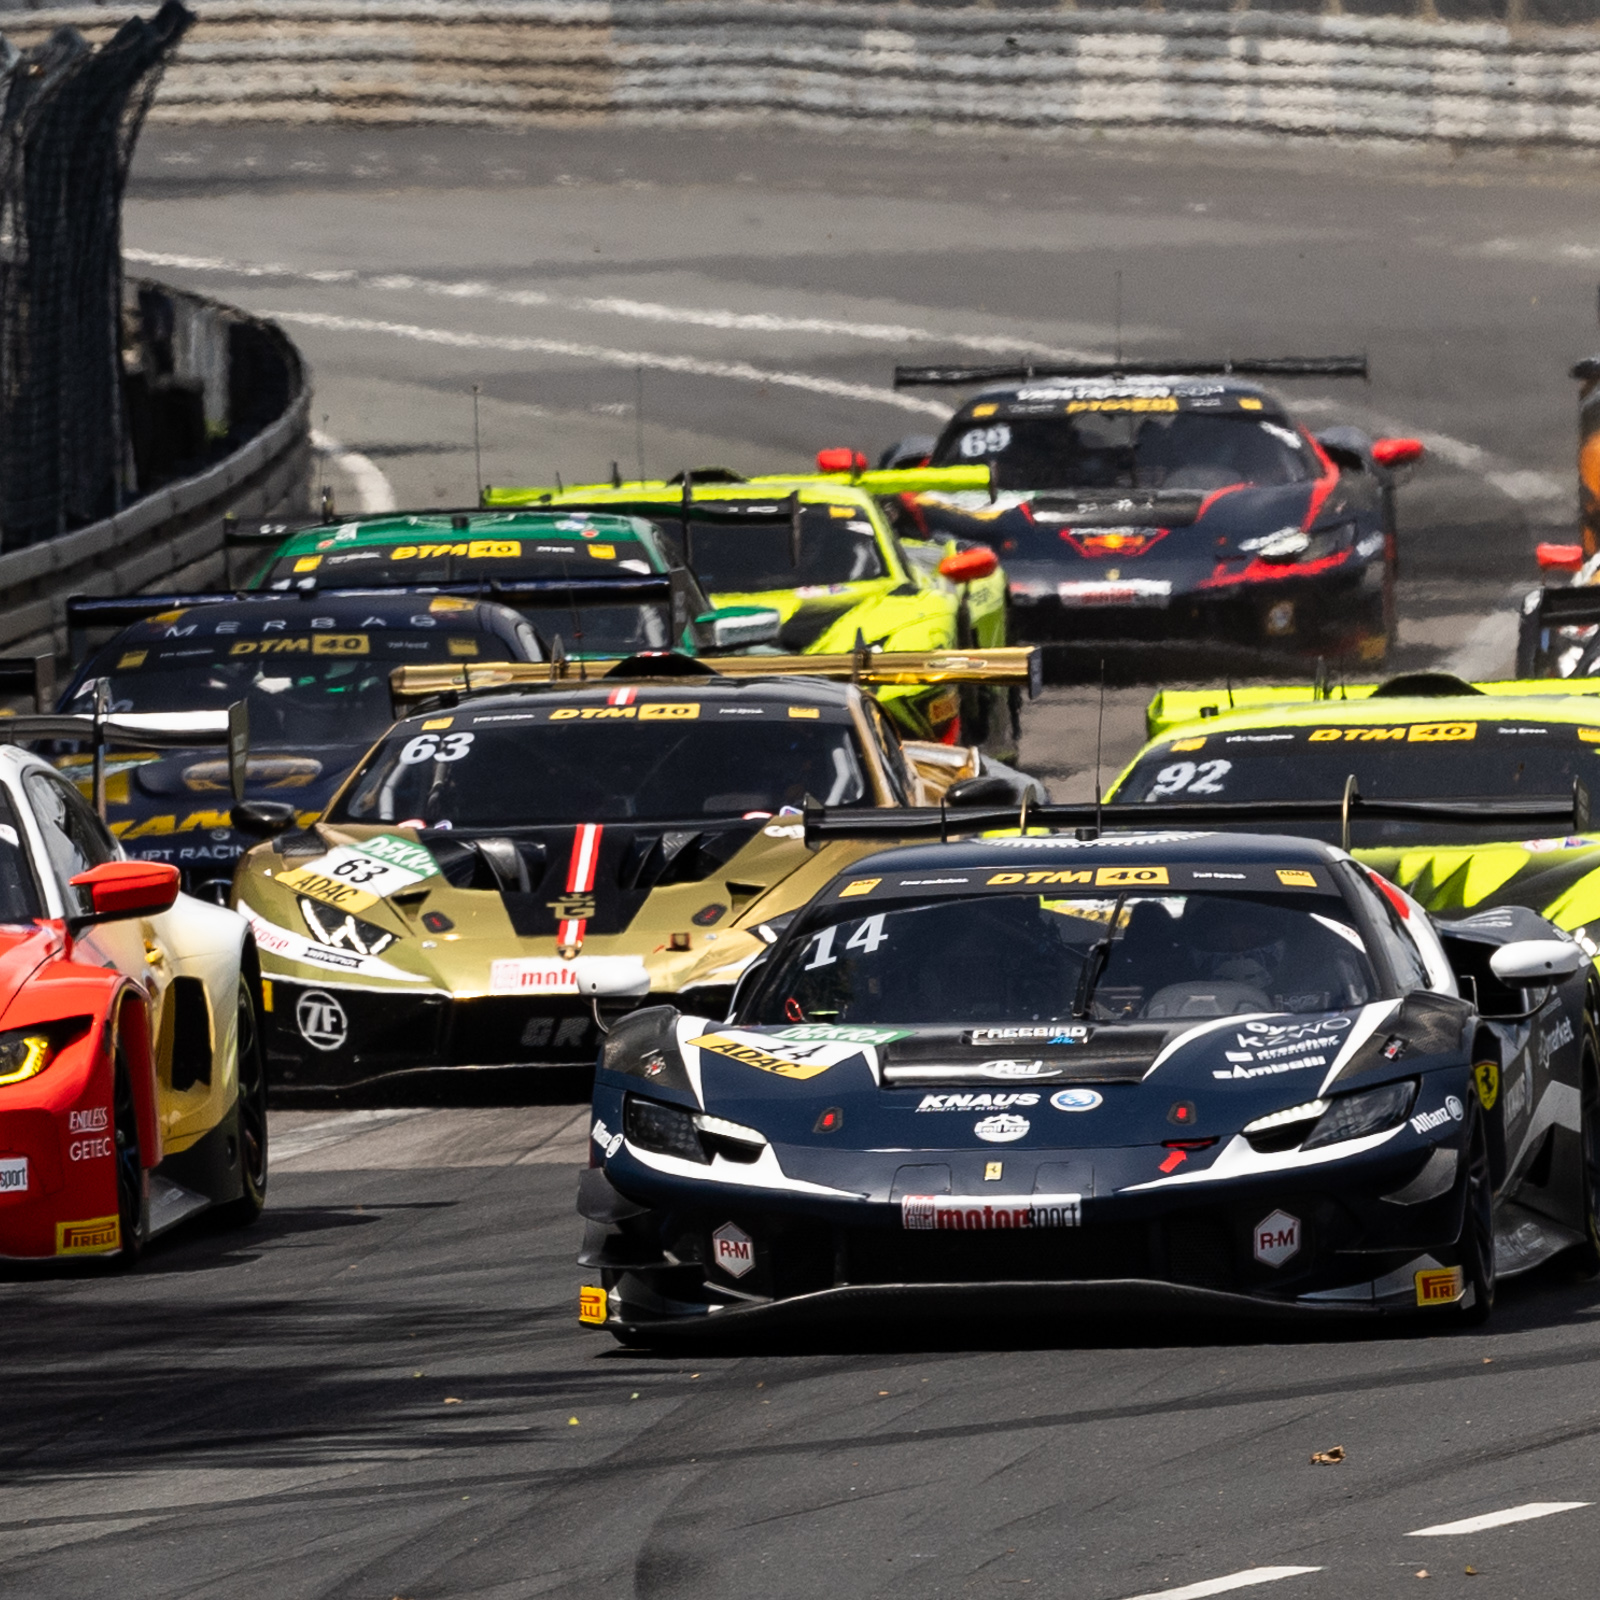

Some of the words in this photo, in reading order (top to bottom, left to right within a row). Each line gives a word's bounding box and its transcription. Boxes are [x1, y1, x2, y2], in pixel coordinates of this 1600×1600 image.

[960, 424, 1012, 458] 69
[164, 613, 437, 639] MERBAG
[229, 637, 310, 656] DTM
[320, 636, 362, 651] 40
[549, 708, 637, 720] DTM
[645, 706, 692, 718] 40
[1308, 728, 1406, 742] DTM
[1411, 725, 1467, 738] 40
[401, 732, 475, 765] 63
[1154, 759, 1233, 795] 92
[179, 846, 244, 860] RACIN
[333, 858, 389, 884] 63
[987, 870, 1093, 886] DTM
[1106, 870, 1159, 882] 40
[293, 873, 359, 903] ADAC
[804, 913, 889, 971] 14
[772, 1025, 899, 1044] DEKRA
[971, 1026, 1087, 1039] FREEBIRD
[710, 1042, 801, 1074] ADAC
[918, 1093, 1041, 1109] KNAUS
[68, 1106, 109, 1131] ENDLESS
[1409, 1106, 1451, 1135] Allianz
[69, 1136, 112, 1162] GETEC
[937, 1202, 1079, 1230] motorsport
[62, 1220, 117, 1249] PIRELLI
[1259, 1228, 1296, 1250] R-M
[719, 1239, 750, 1260] R-M
